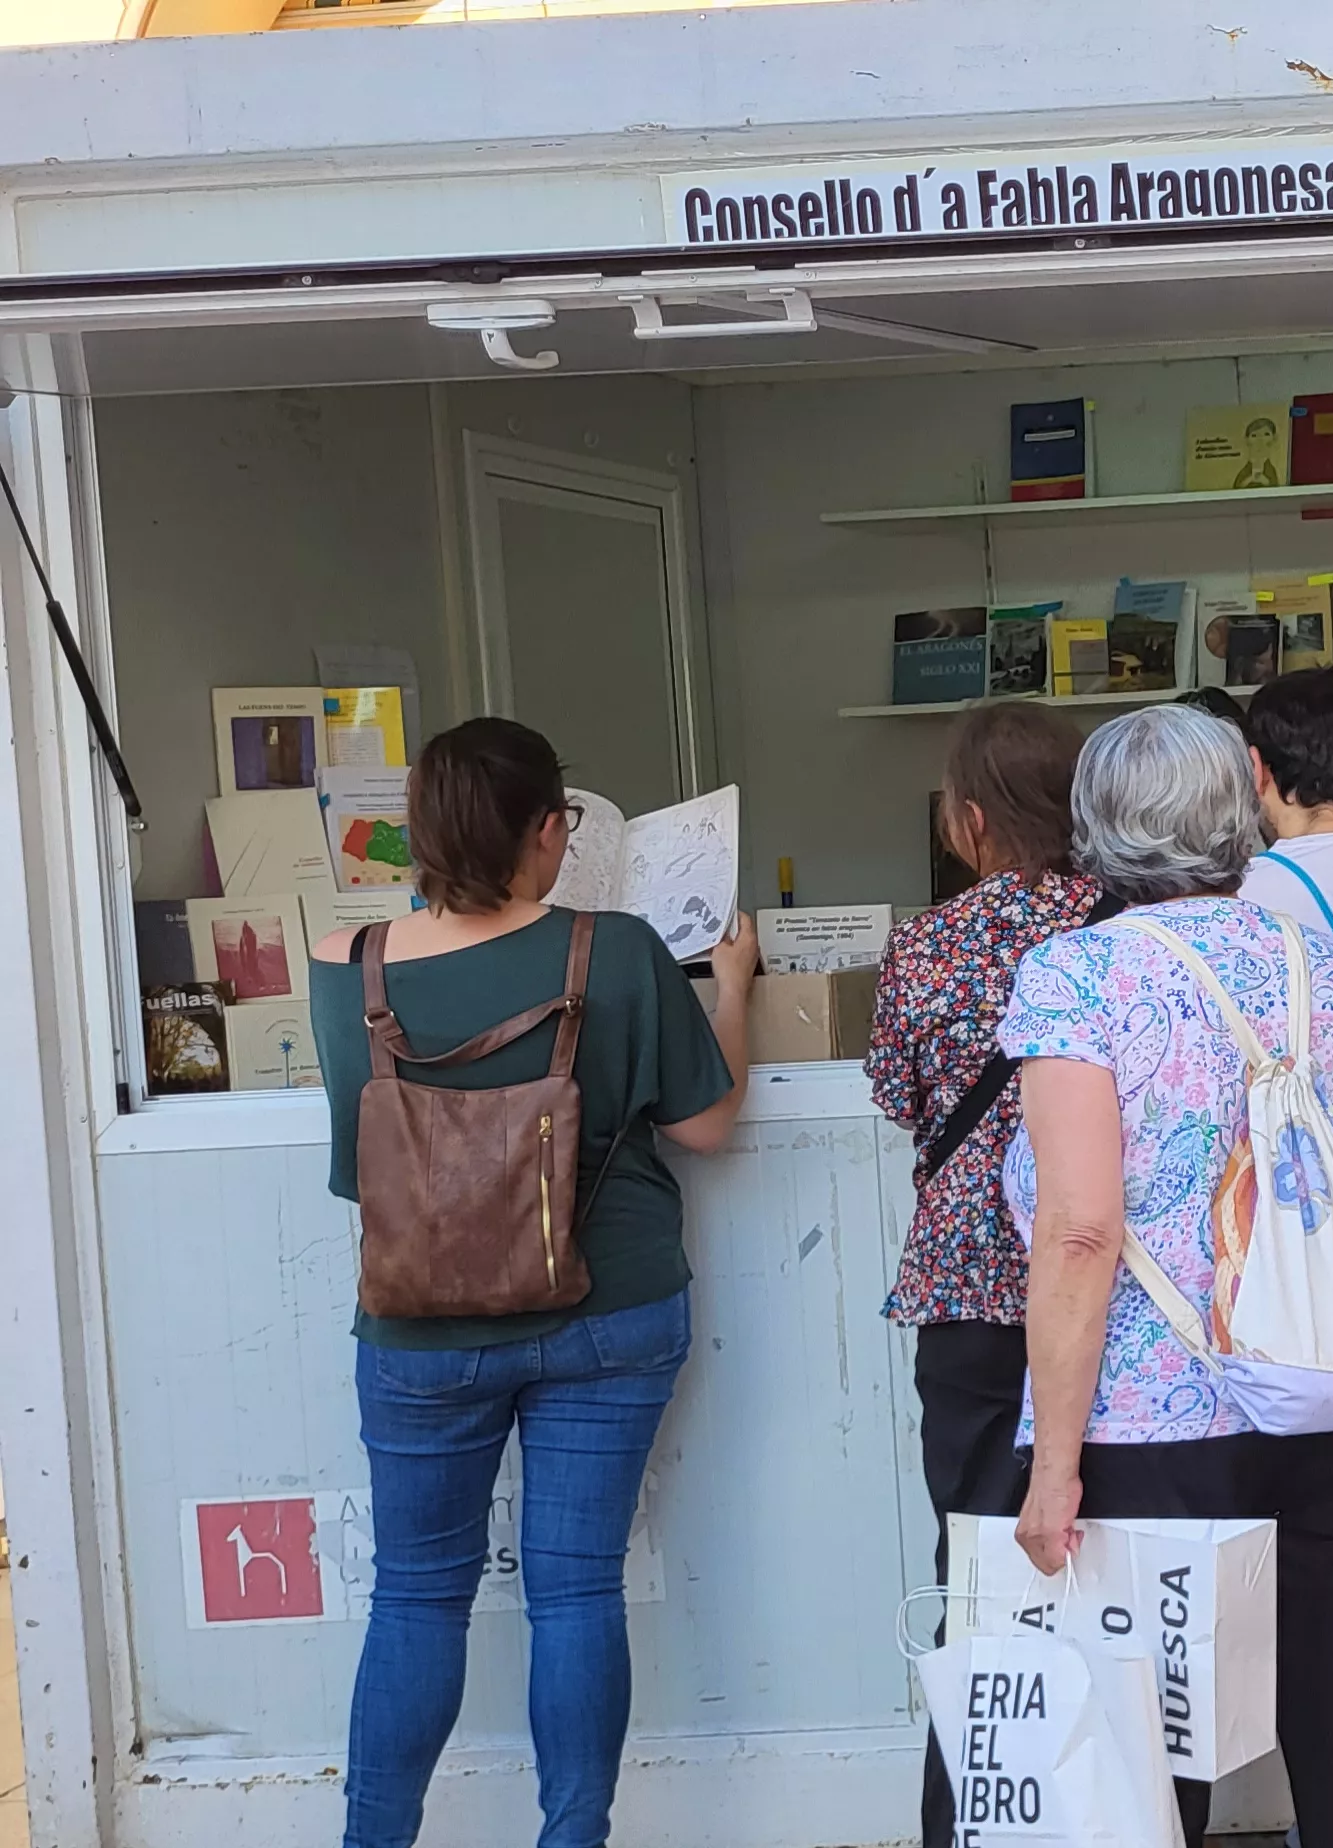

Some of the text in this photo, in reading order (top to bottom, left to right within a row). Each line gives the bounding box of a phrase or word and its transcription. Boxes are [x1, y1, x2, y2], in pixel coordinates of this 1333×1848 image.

[685, 178, 882, 243] Consello
[977, 165, 1096, 228] Fabla
[140, 991, 214, 1010] uellas
[1159, 1564, 1193, 1759] HUESCA
[967, 1672, 1047, 1719] ERIA
[961, 1724, 1003, 1770] EL
[953, 1775, 1041, 1824] IBRO
